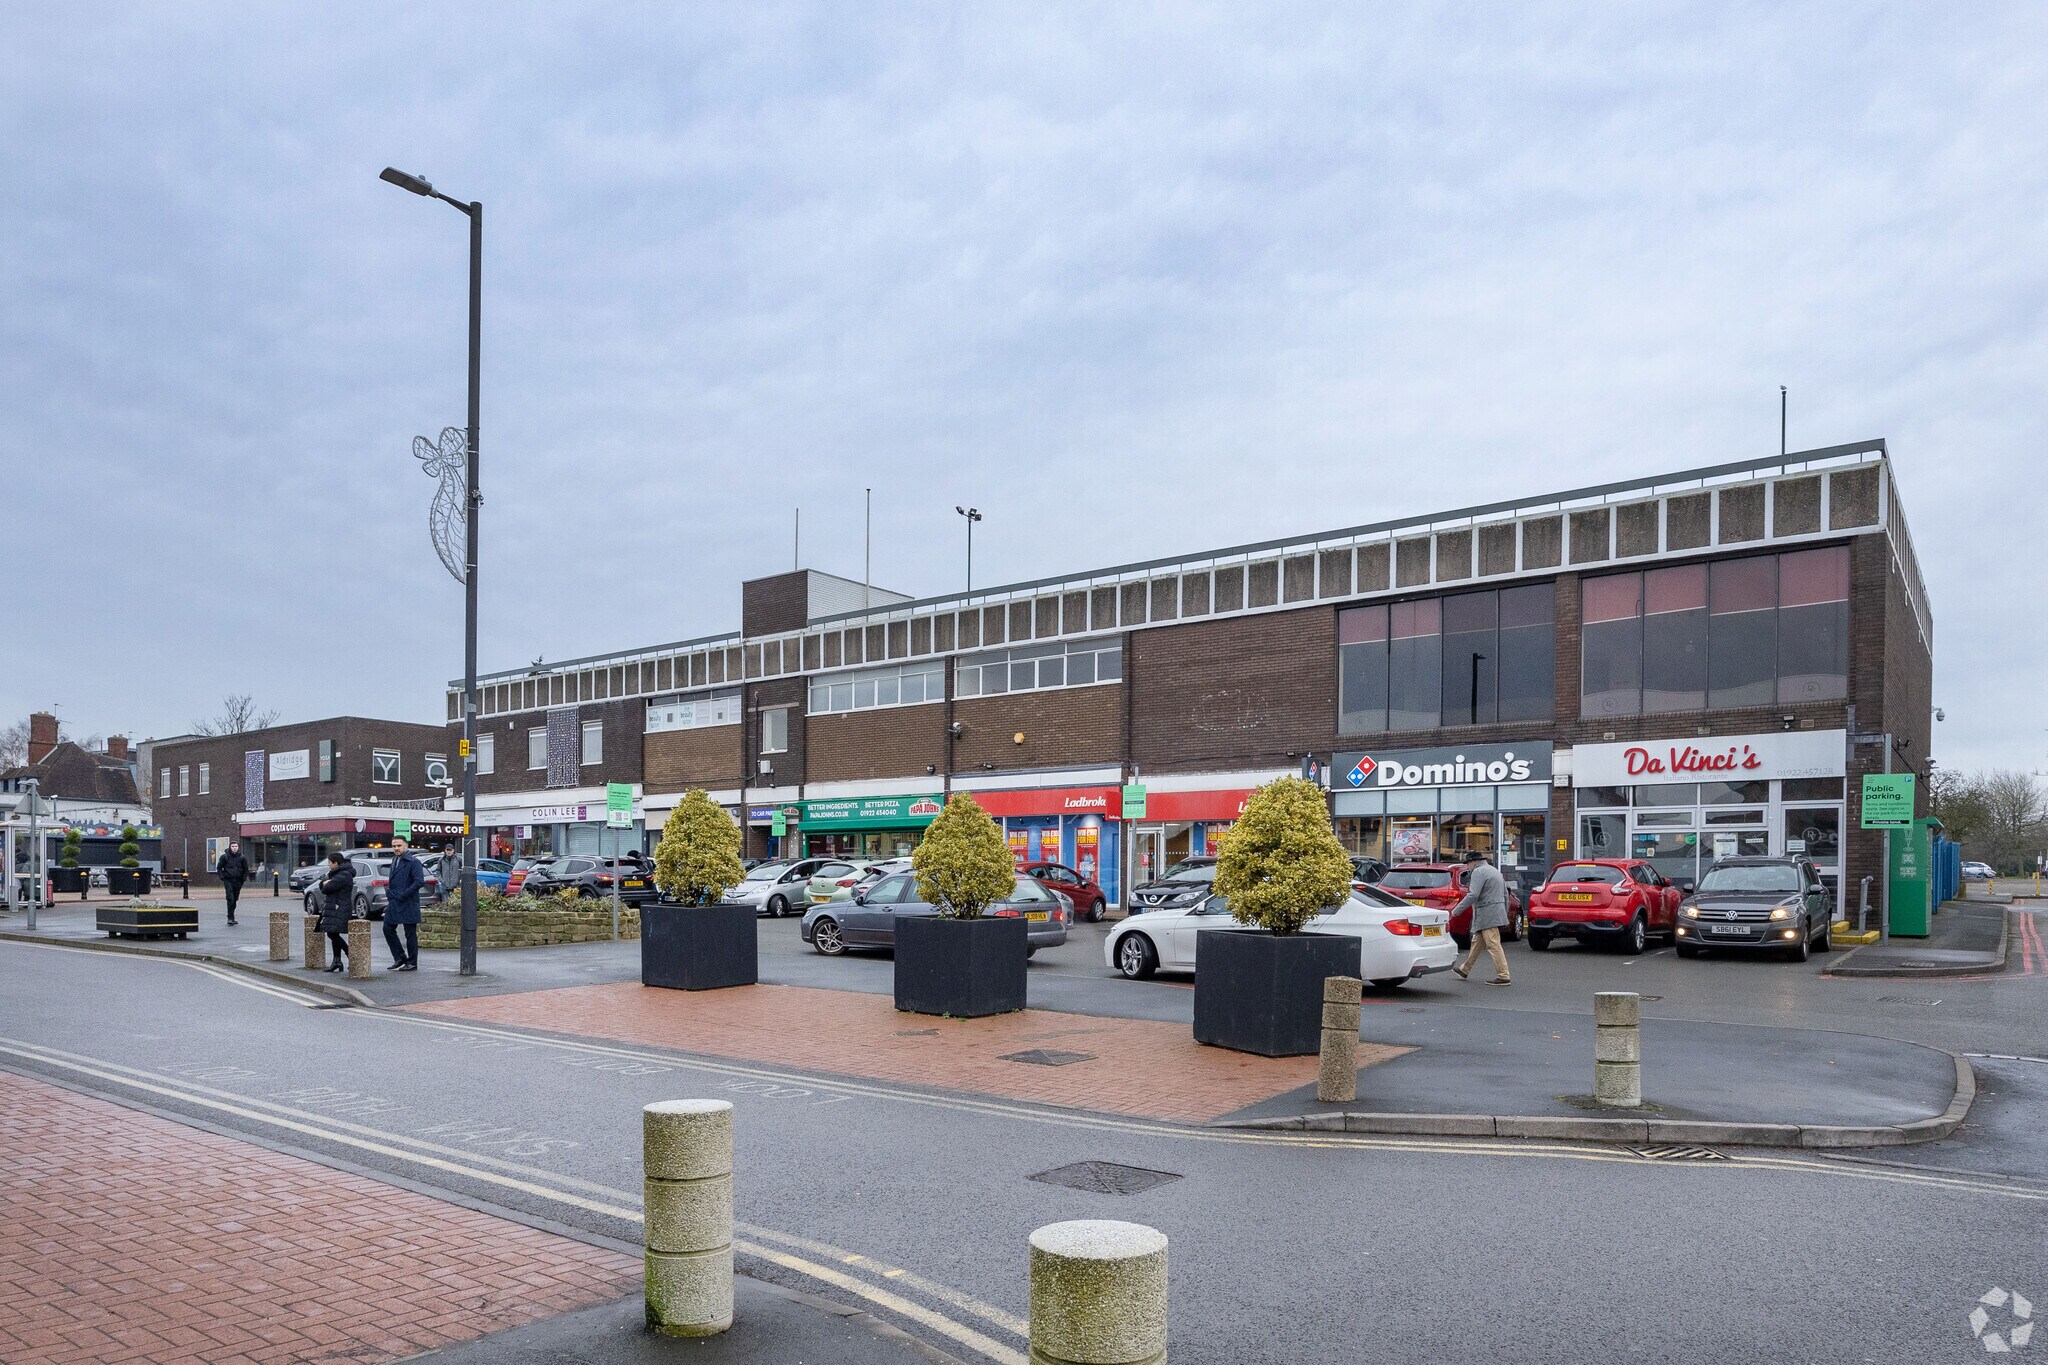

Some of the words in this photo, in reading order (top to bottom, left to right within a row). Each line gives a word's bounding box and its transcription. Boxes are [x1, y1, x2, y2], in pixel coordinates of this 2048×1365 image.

[276, 754, 303, 766] Aldridge
[1624, 747, 1665, 775] Da
[1670, 745, 1761, 773] Vinci's
[376, 757, 396, 780] Y
[1377, 751, 1531, 787] Domino's
[1777, 769, 1801, 777] 01922
[1865, 793, 1904, 801] parking.
[865, 801, 884, 809] BETTER
[910, 803, 923, 814] PAPA
[924, 803, 940, 814] JOHNS
[532, 808, 557, 817] COLIN
[561, 807, 576, 816] LEE
[270, 825, 285, 833] COSTA
[286, 823, 305, 832] COFFEE
[411, 825, 442, 833] COSTA
[1051, 836, 1059, 844] FRE
[1087, 835, 1098, 843] FREE
[1558, 840, 1566, 849] H
[414, 1119, 579, 1156] WAYS
